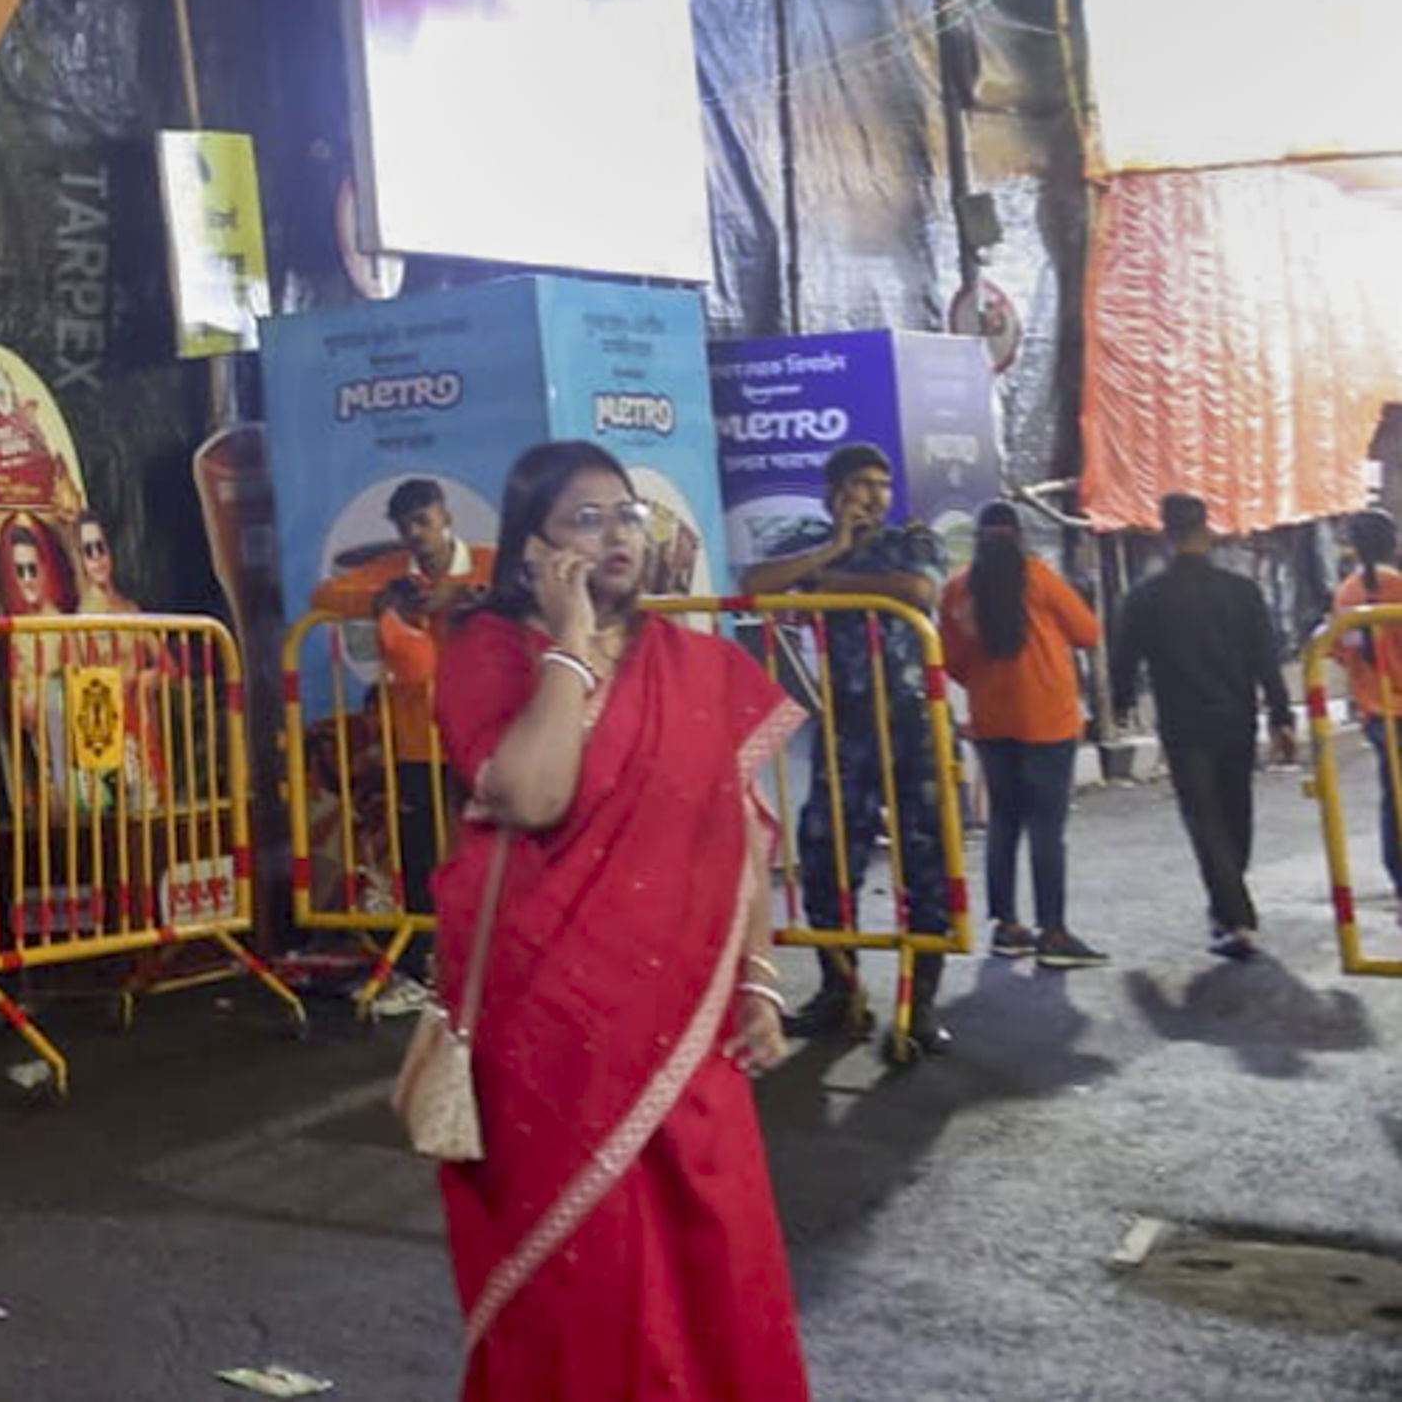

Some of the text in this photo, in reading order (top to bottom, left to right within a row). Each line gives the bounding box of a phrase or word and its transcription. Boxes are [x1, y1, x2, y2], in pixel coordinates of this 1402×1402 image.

[54, 162, 109, 391] TARPEX
[337, 371, 462, 420] METRO
[593, 394, 674, 435] METRO
